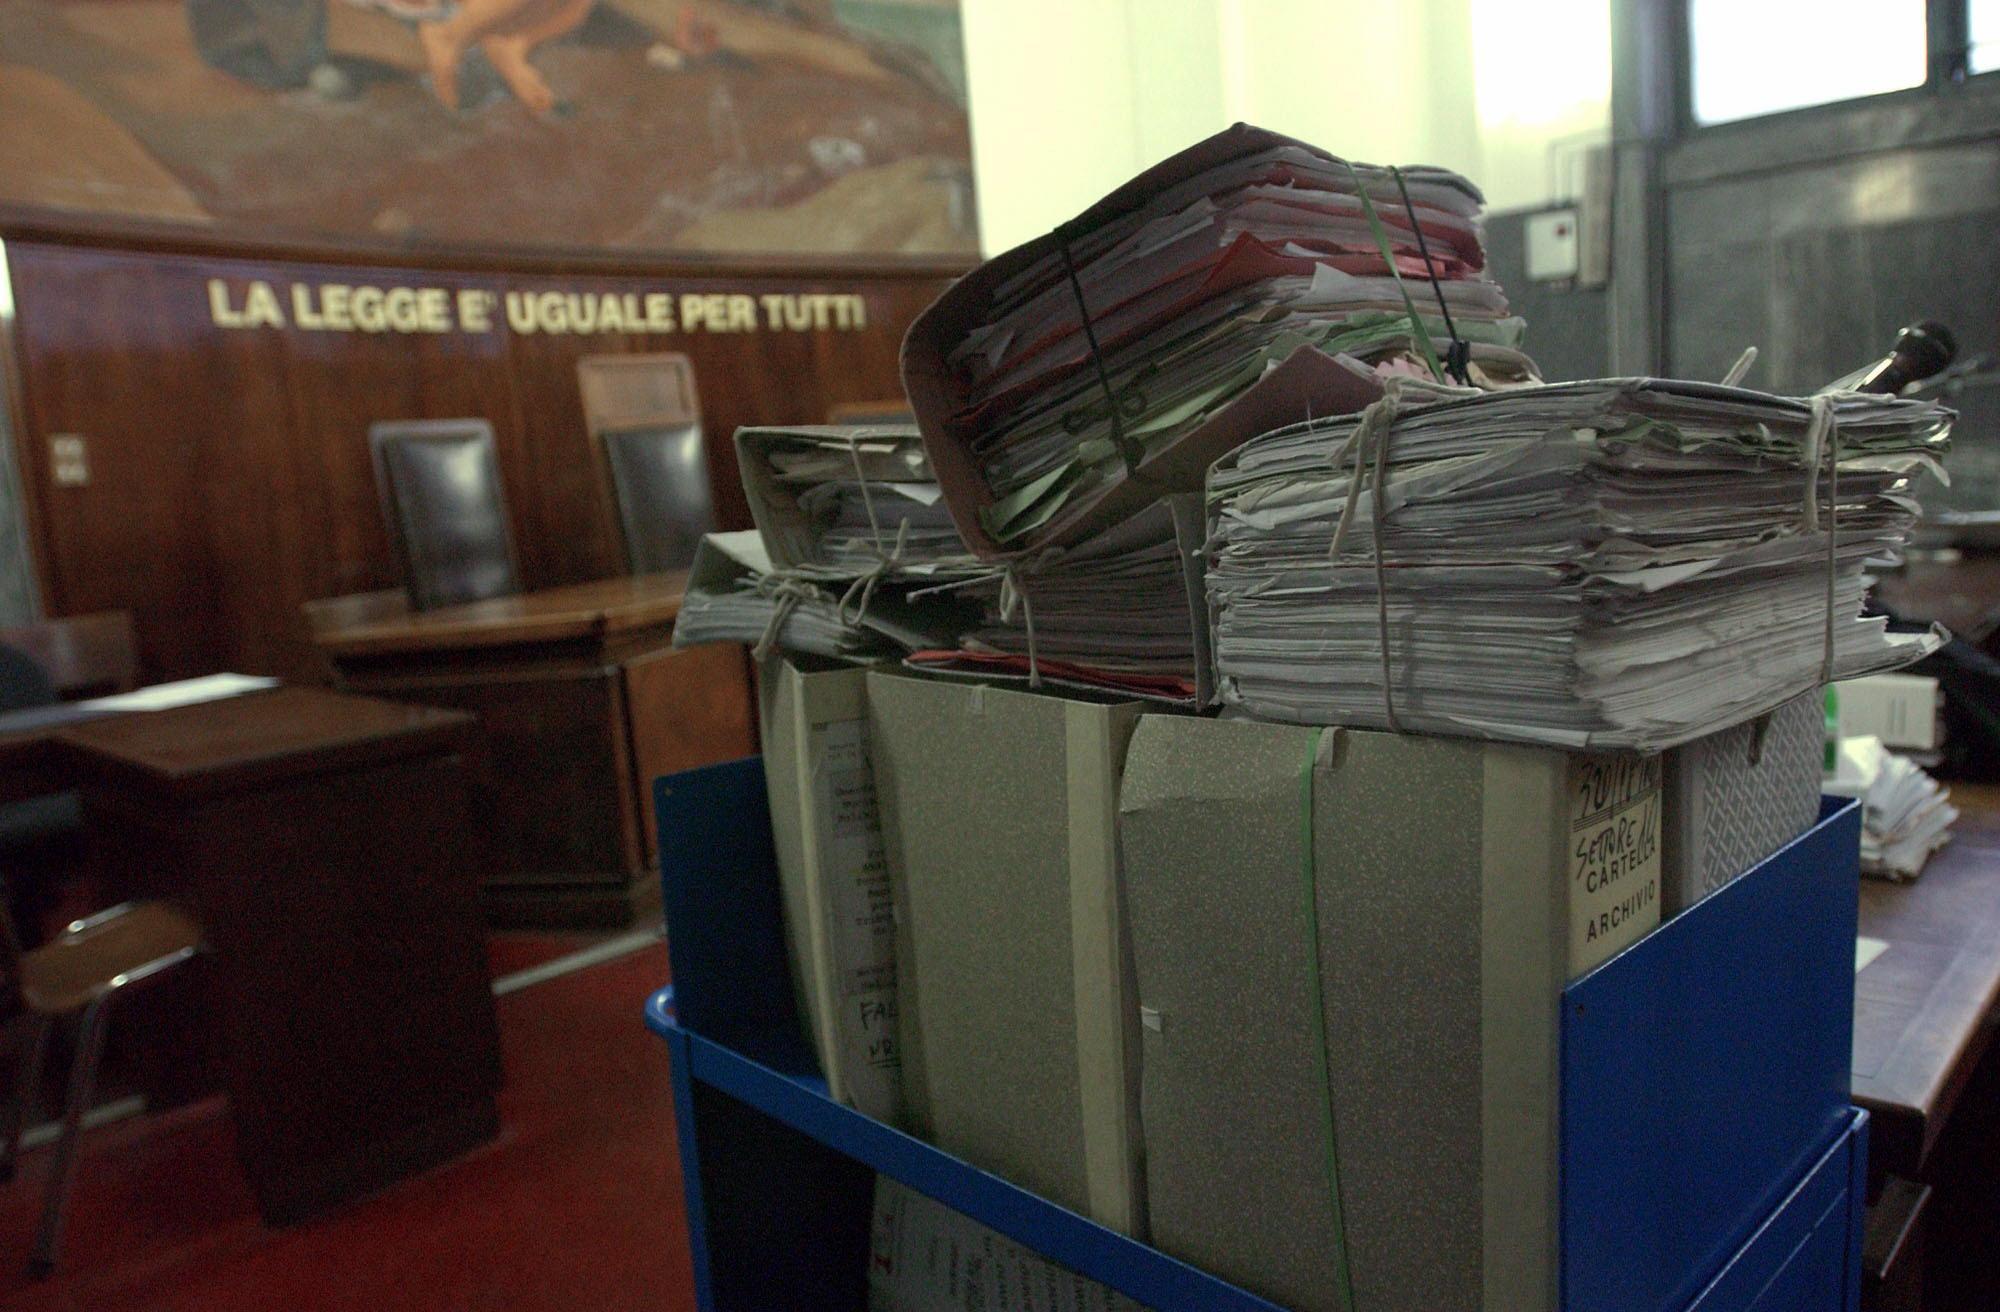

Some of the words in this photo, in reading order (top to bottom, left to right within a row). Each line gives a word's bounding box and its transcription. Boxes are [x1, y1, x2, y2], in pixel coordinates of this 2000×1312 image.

[208, 278, 286, 329] LA
[291, 282, 451, 333] LEGGE
[505, 291, 676, 335] UGUALE
[679, 293, 757, 333] PER
[760, 294, 866, 331] TUTTI
[1586, 833, 1656, 893] CARTELLA
[1586, 879, 1656, 943] ARCHIVIO
